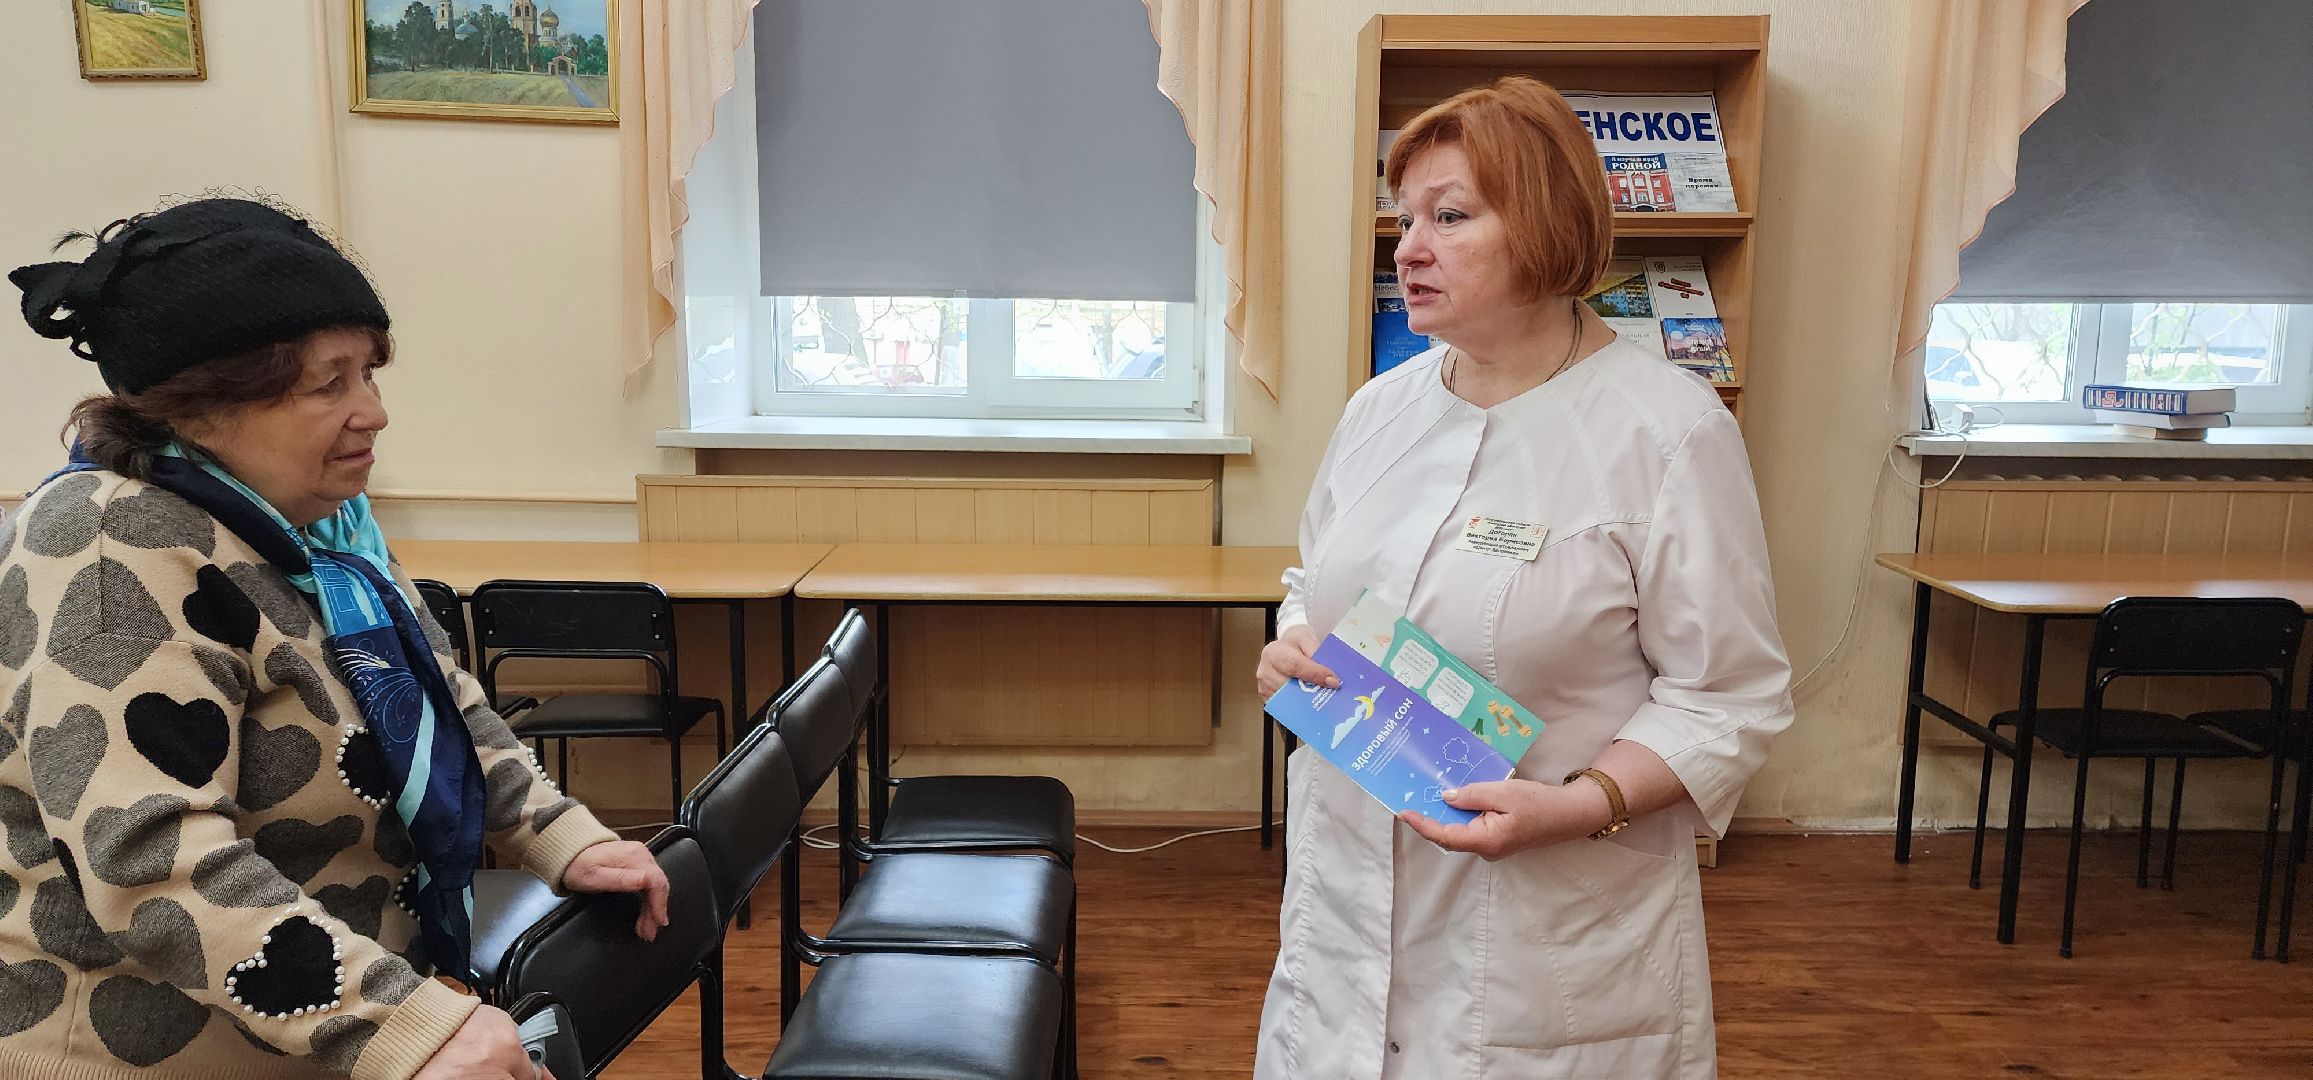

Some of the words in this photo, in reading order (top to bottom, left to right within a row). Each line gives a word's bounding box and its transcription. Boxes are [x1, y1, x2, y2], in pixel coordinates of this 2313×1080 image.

[1611, 160, 1662, 171] РОДНОЙ
[1351, 717, 1398, 772] ЗДОРОВЫЙ
[1394, 697, 1414, 720] СОН
